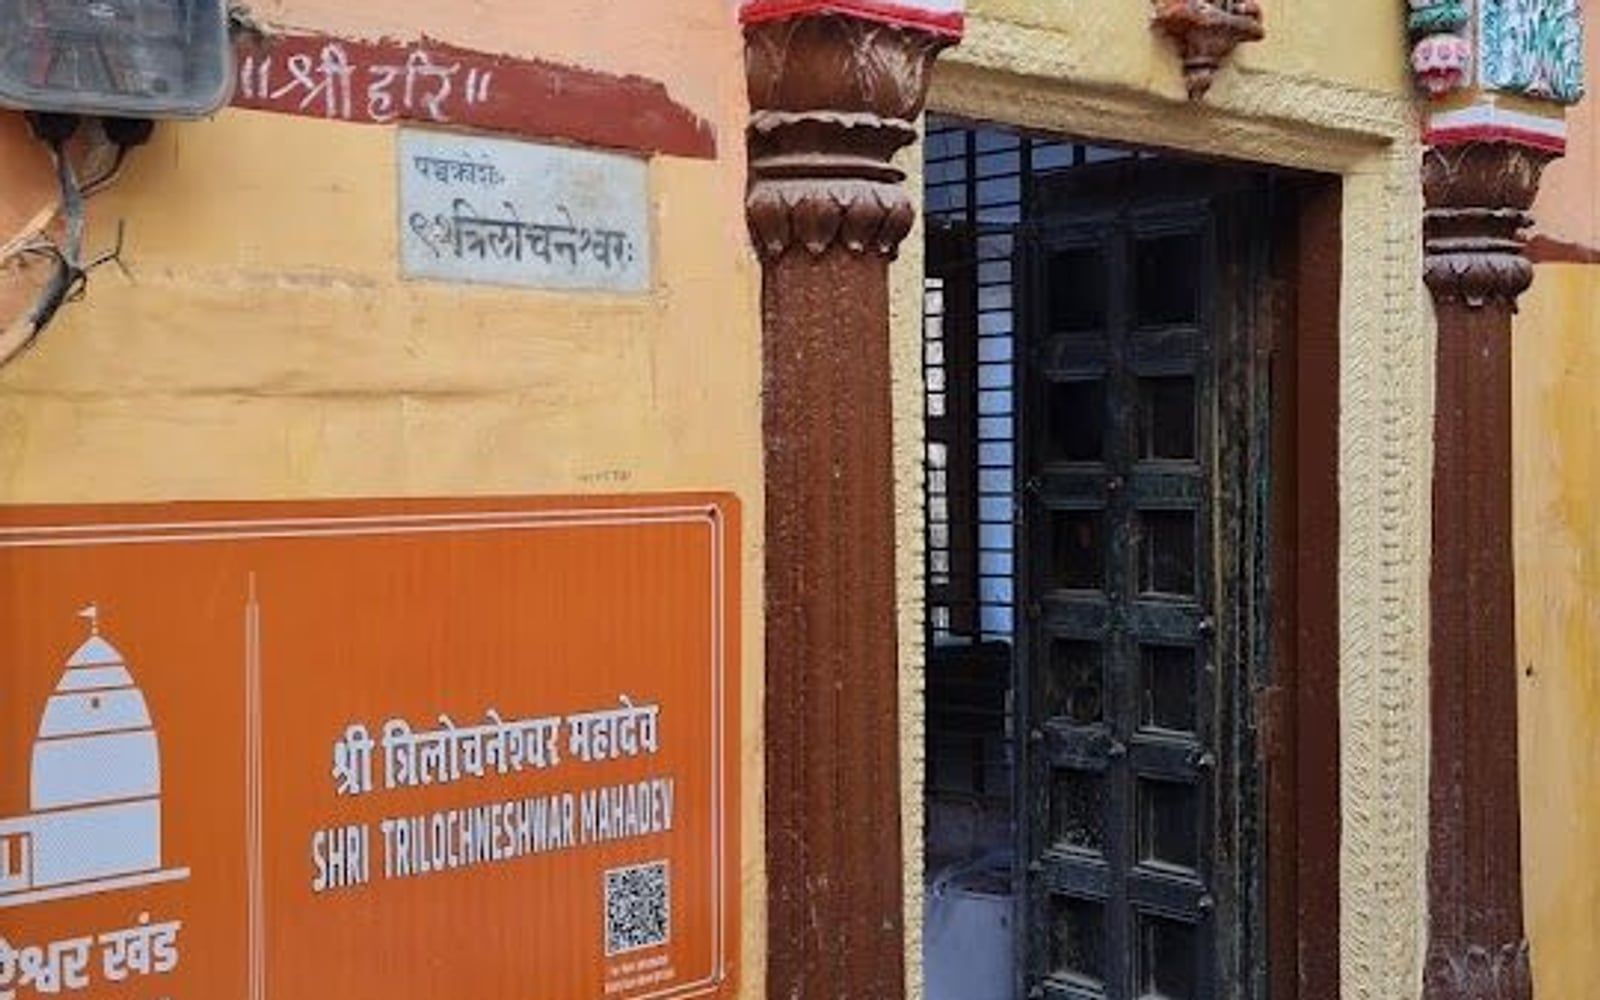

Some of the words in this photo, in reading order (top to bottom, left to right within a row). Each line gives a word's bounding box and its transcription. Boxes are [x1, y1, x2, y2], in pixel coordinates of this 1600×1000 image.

[333, 724, 374, 795] श्री
[383, 709, 561, 789] त्रिलोचनेश्वर
[567, 695, 660, 762] महादेव
[311, 825, 369, 892] SHRI
[380, 793, 577, 880] TRILOCHNESHWAR
[580, 778, 675, 843] MAHADEV
[98, 911, 183, 981] खंड
